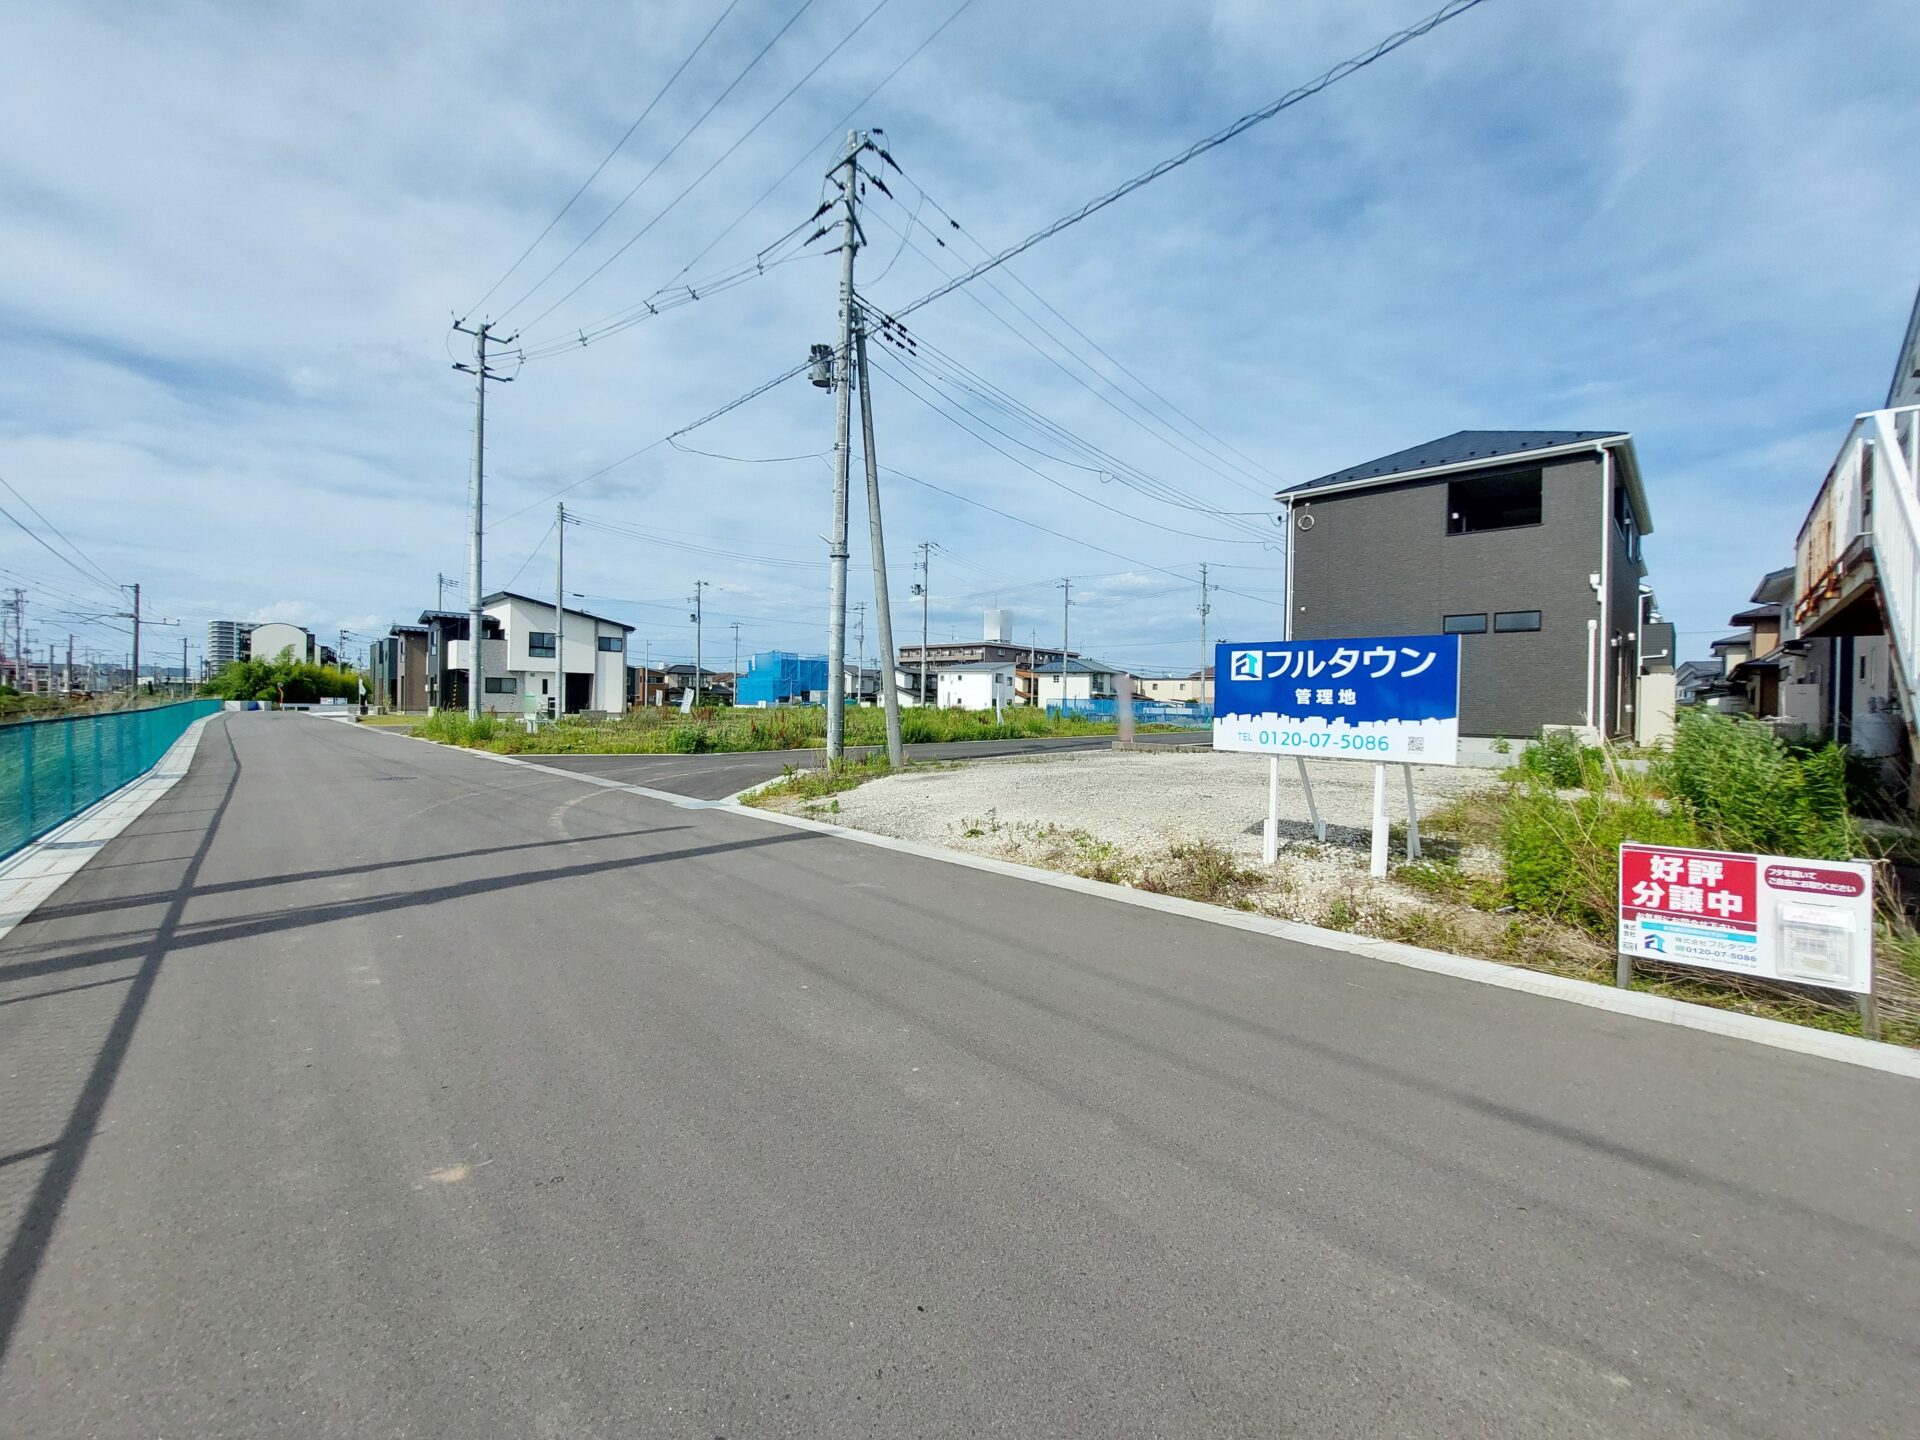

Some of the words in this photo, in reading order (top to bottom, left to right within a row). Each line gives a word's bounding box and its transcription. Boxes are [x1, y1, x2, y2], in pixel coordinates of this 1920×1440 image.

[1266, 646, 1437, 679] フルタウン
[1295, 688, 1357, 705] 管理地
[1238, 732, 1253, 742] TEL
[1259, 730, 1390, 751] 0120-07-5086
[1650, 855, 1724, 887] 好評
[1632, 880, 1743, 918] 分譲中
[1674, 937, 1758, 953] 株式会社フルタウン
[1686, 947, 1757, 962] 0120-07-5086
